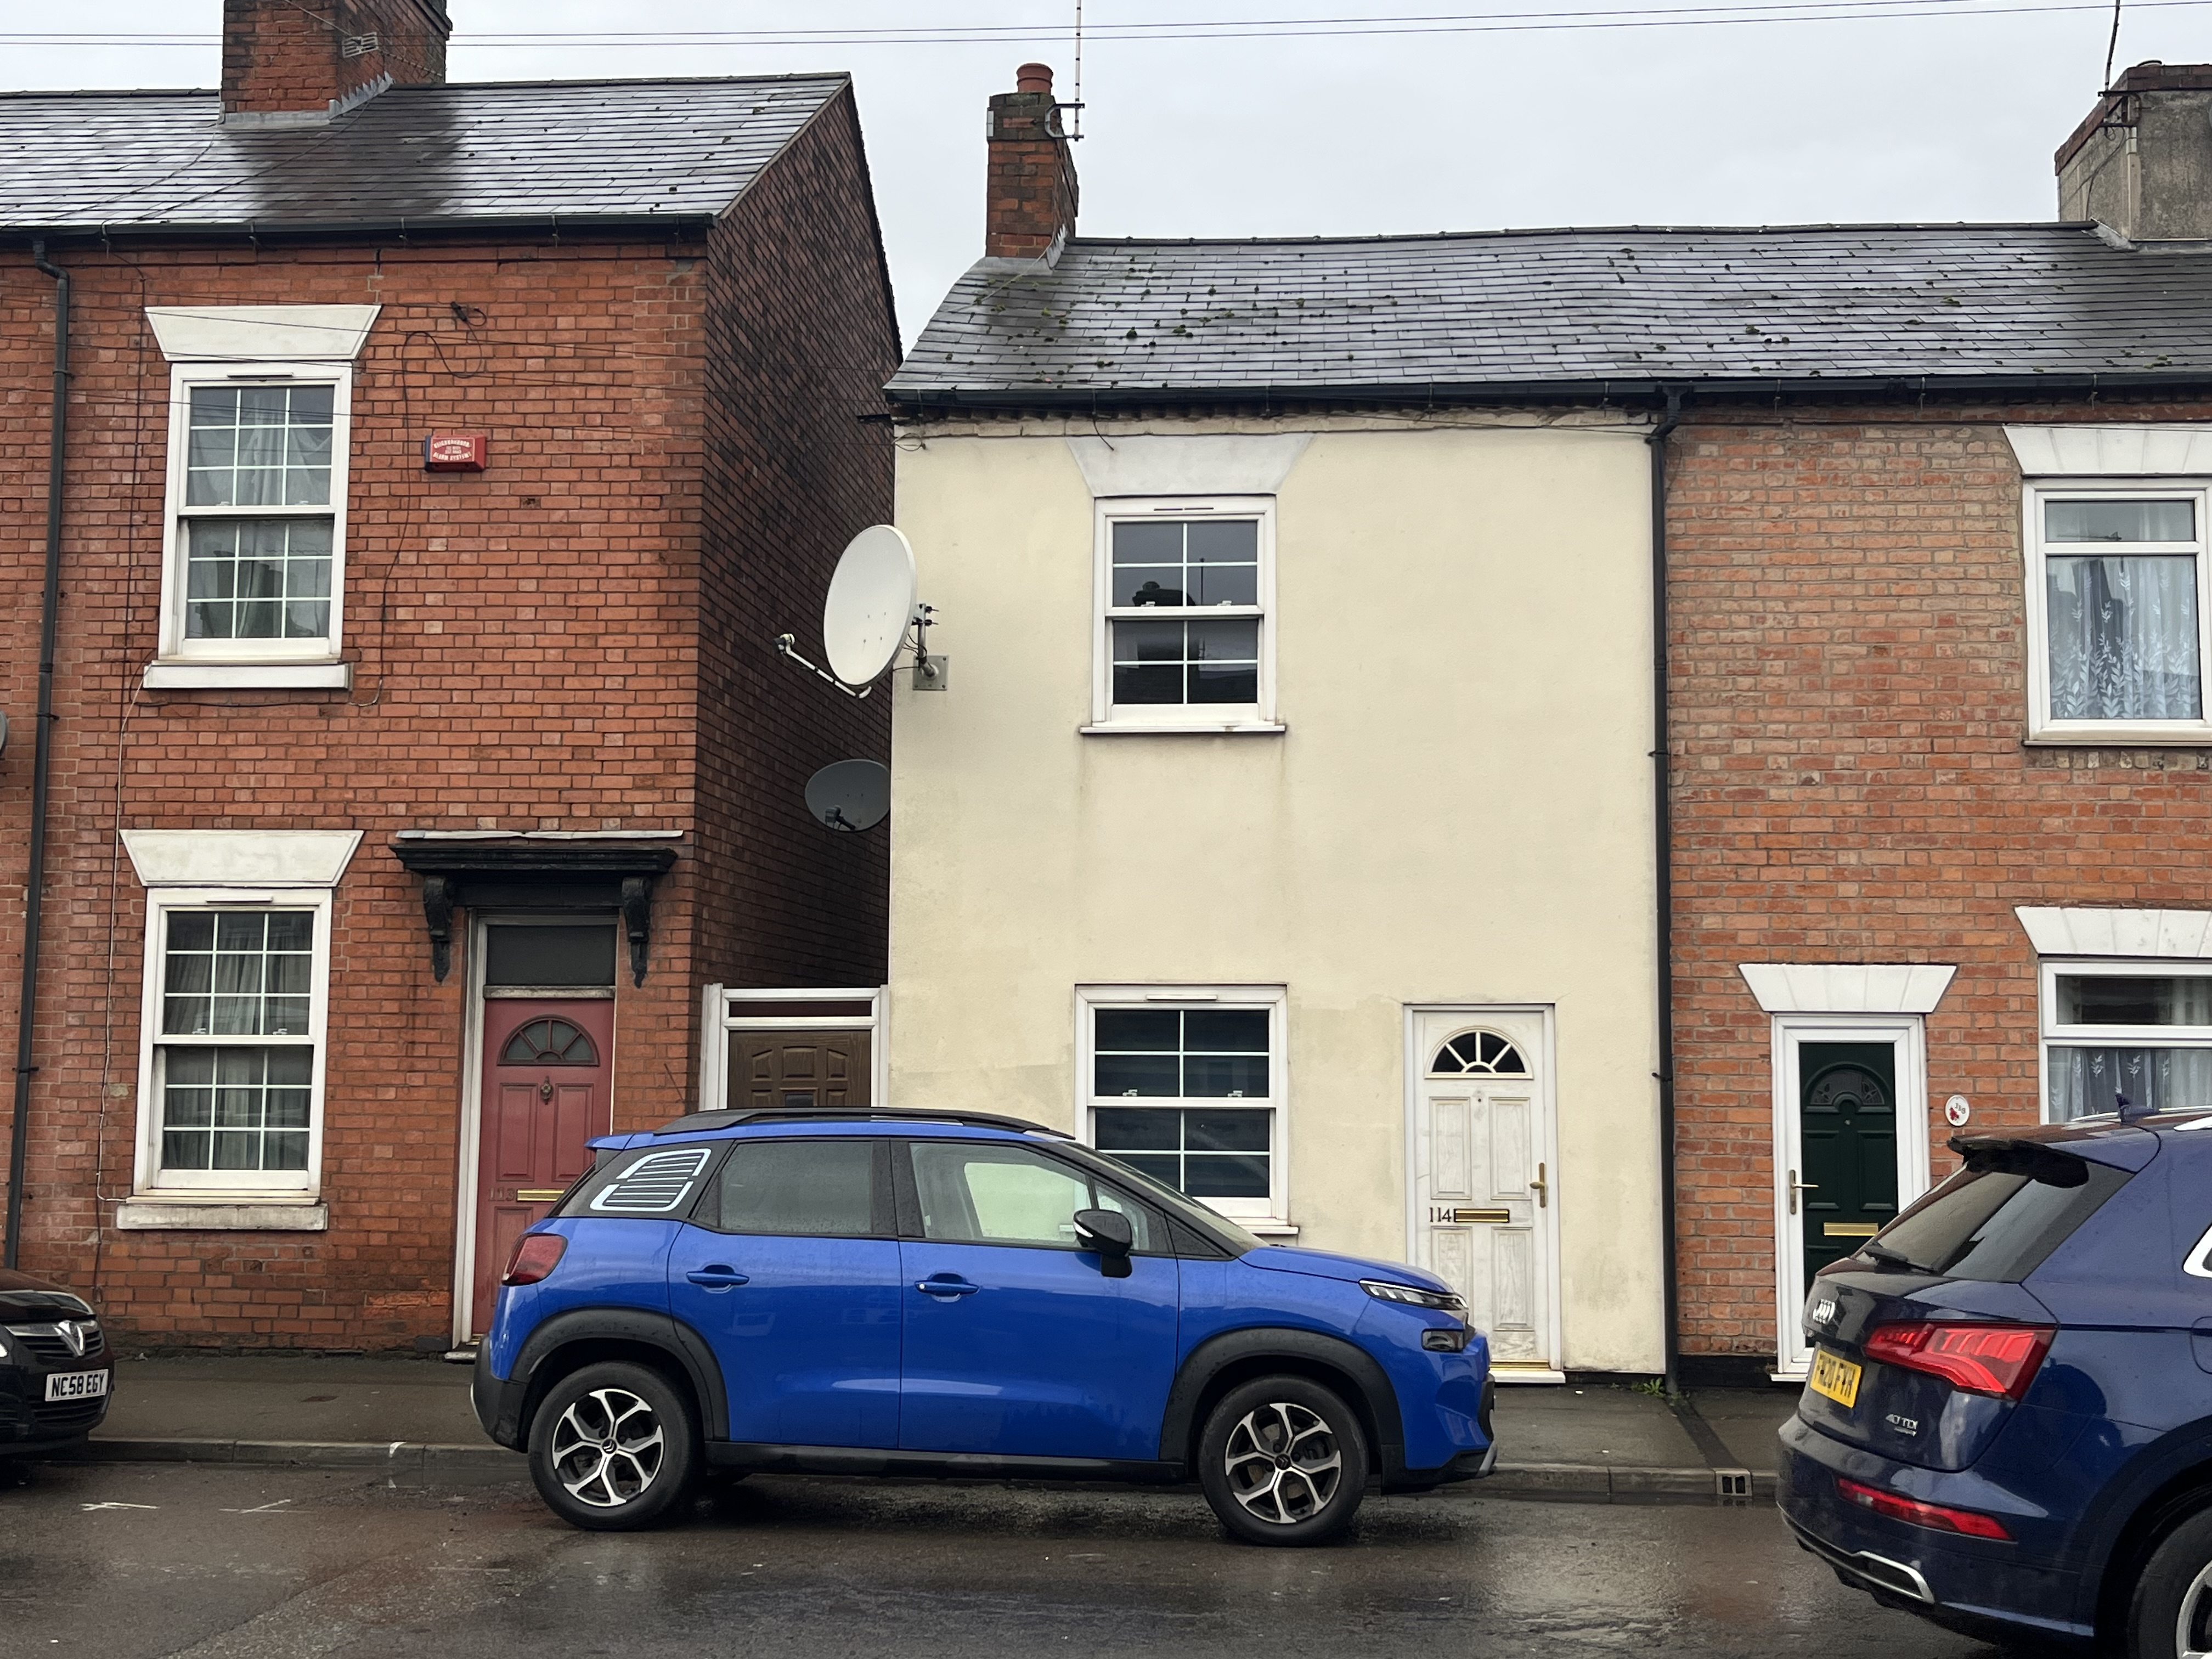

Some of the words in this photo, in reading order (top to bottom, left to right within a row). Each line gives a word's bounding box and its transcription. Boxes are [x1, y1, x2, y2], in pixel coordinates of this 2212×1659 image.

[489, 1187, 515, 1201] 113
[1429, 1207, 1452, 1222] 114
[86, 1373, 105, 1393] EGY
[1885, 1414, 1900, 1425] 40
[1901, 1417, 1918, 1430] TDI
